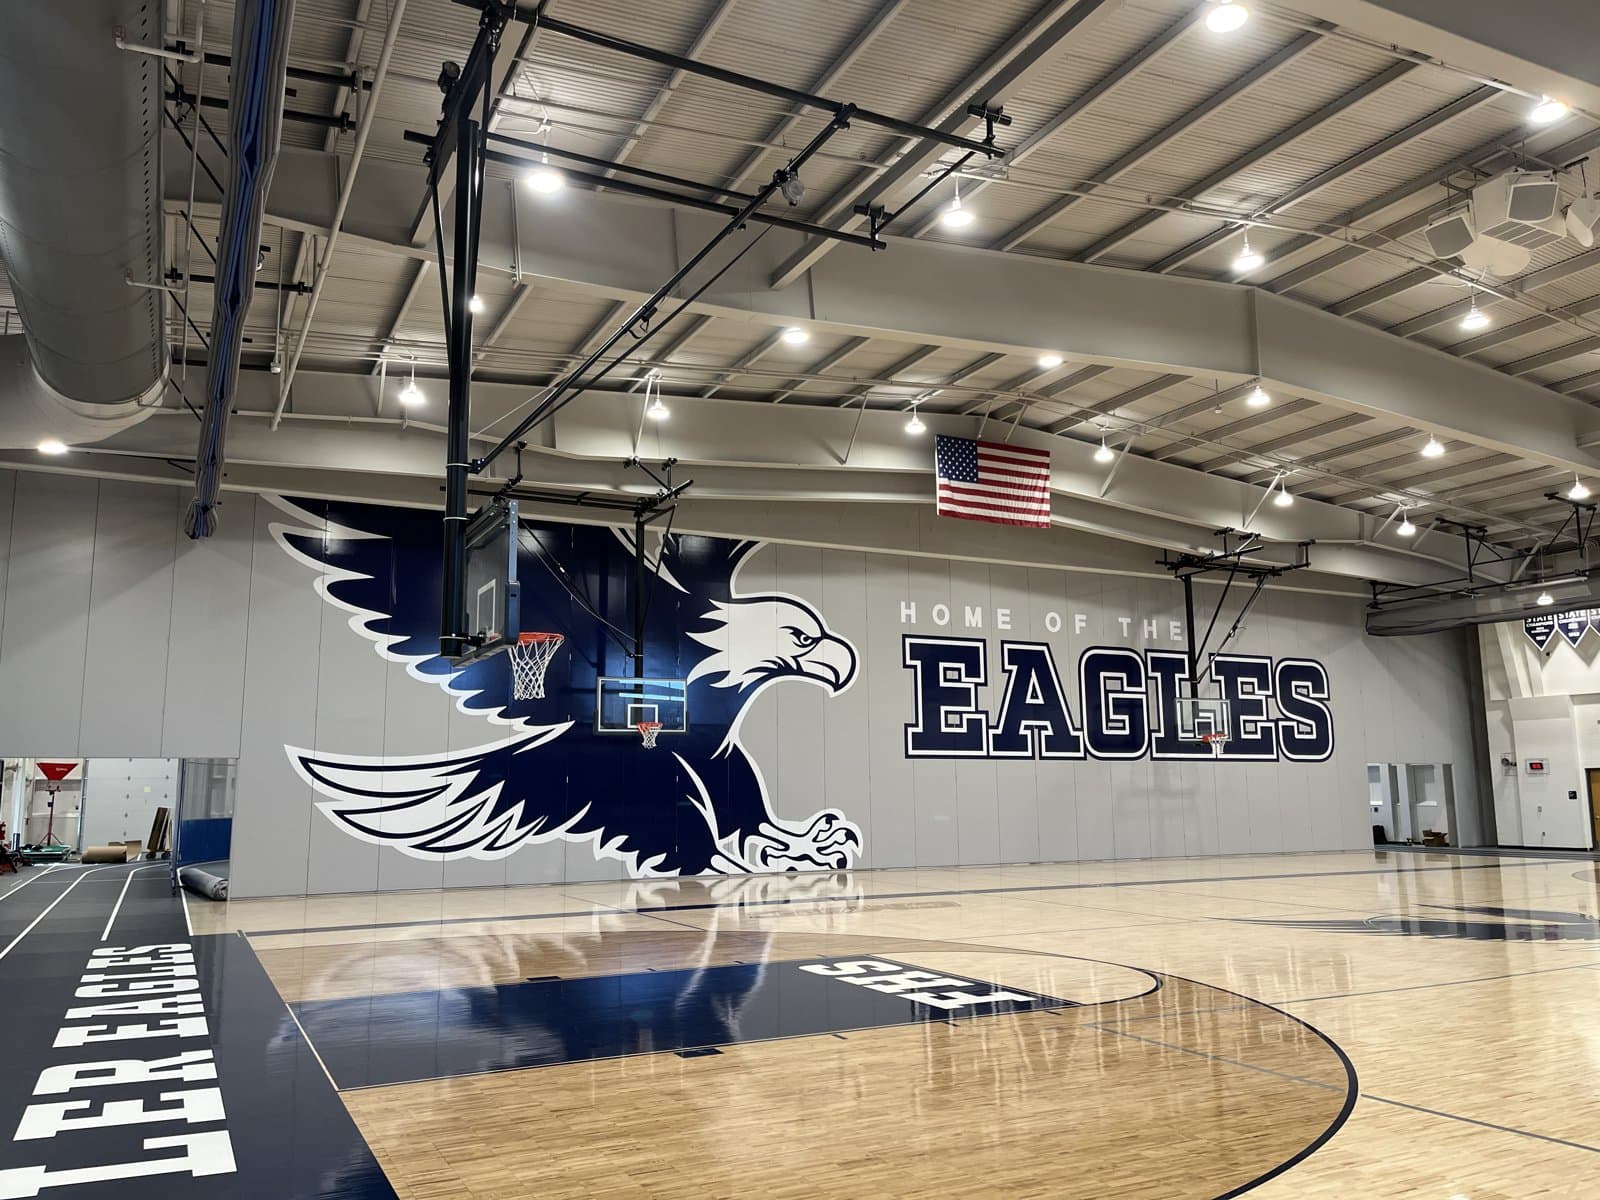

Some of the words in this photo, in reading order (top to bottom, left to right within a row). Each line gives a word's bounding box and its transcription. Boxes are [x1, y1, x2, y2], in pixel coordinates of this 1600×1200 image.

[900, 601, 1011, 630] HOME
[1045, 611, 1087, 634] OF
[1118, 617, 1183, 641] THE
[902, 633, 1335, 763] EAGLES
[52, 943, 209, 1048] EAGLES
[798, 960, 1038, 1010] FHS
